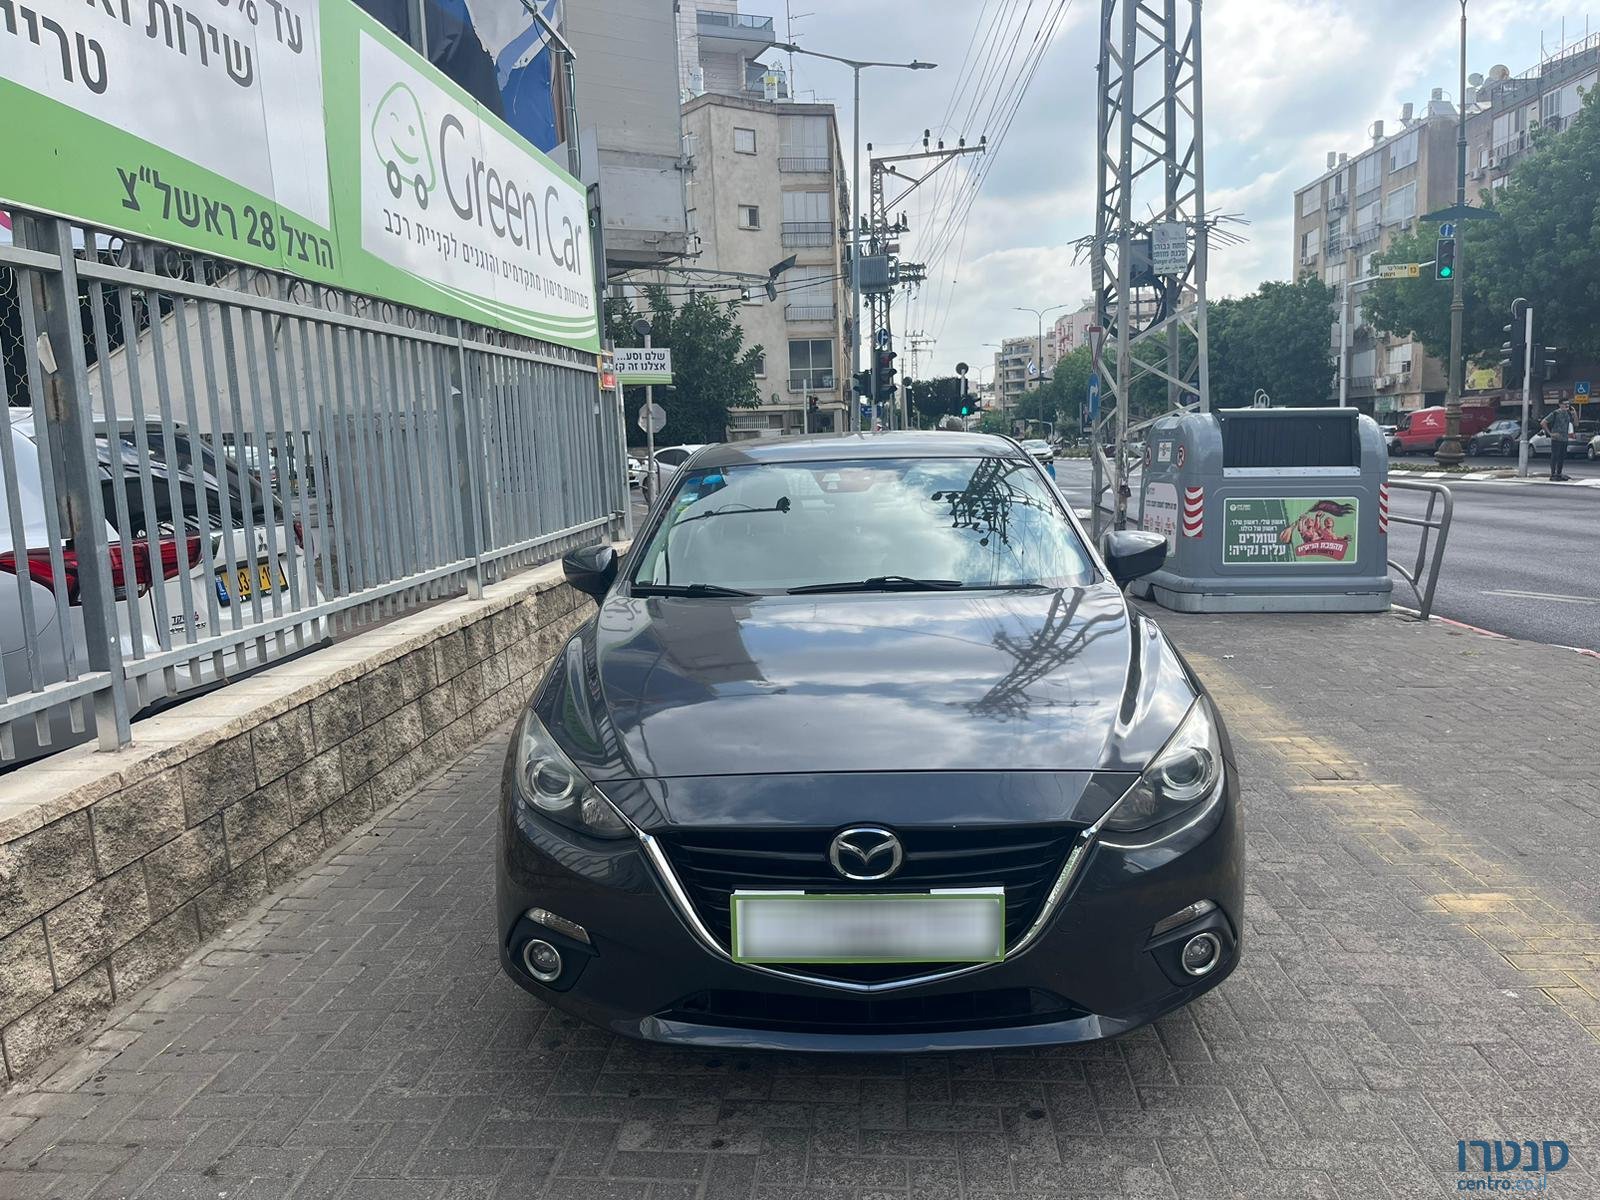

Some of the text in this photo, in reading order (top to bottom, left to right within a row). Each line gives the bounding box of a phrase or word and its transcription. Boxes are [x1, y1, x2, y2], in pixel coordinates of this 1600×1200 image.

[264, 0, 303, 54] עד
[145, 0, 254, 88] שירות
[440, 113, 582, 276] Green Car
[243, 205, 276, 251] 28
[384, 208, 411, 240] רכב
[280, 215, 335, 270] הרצל
[415, 221, 458, 261] לקניית
[462, 242, 500, 275] והוגנים
[502, 260, 541, 291] מתקדמים
[543, 277, 563, 299] מימון
[628, 362, 638, 371] זה
[641, 361, 666, 371] אצלנו
[645, 351, 665, 360] שלם
[1229, 543, 1286, 557] עליה נקייה!
[1239, 533, 1277, 543] שומרים
